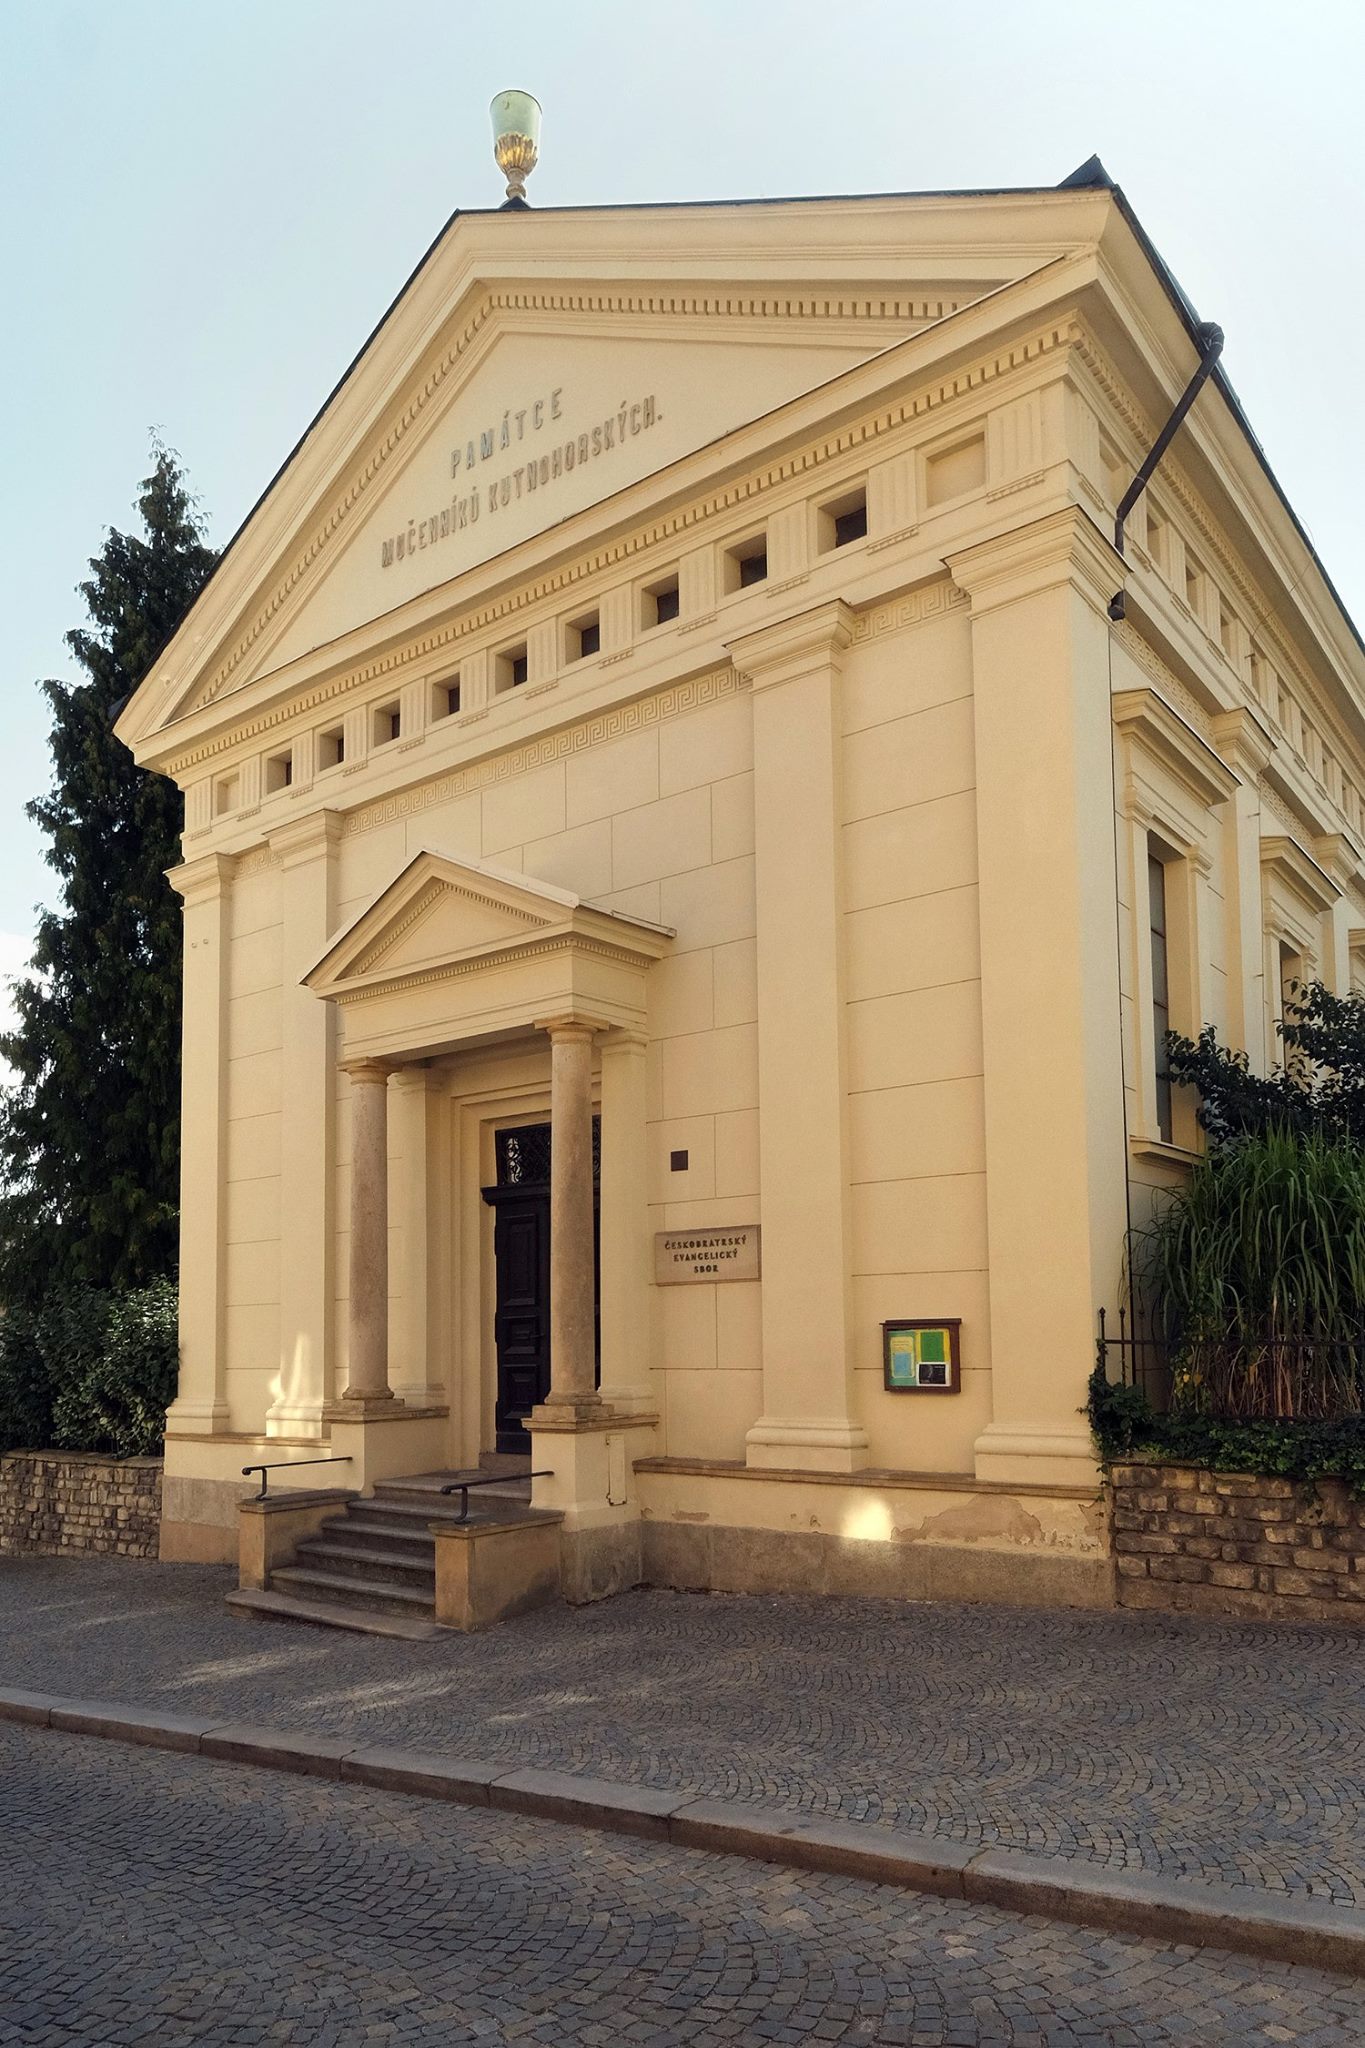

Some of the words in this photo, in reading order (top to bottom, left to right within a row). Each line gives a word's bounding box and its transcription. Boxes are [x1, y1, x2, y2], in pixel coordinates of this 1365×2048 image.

[450, 387, 562, 480] PAMÁTCE
[381, 486, 480, 568] MUČENNÍKŮ
[488, 395, 663, 513] KUTNOHORSKÝCH.
[664, 1234, 747, 1250] ČESKOBRATRSKÝ
[673, 1248, 738, 1262] EVANGELICKÝ
[693, 1264, 719, 1273] SBOR
